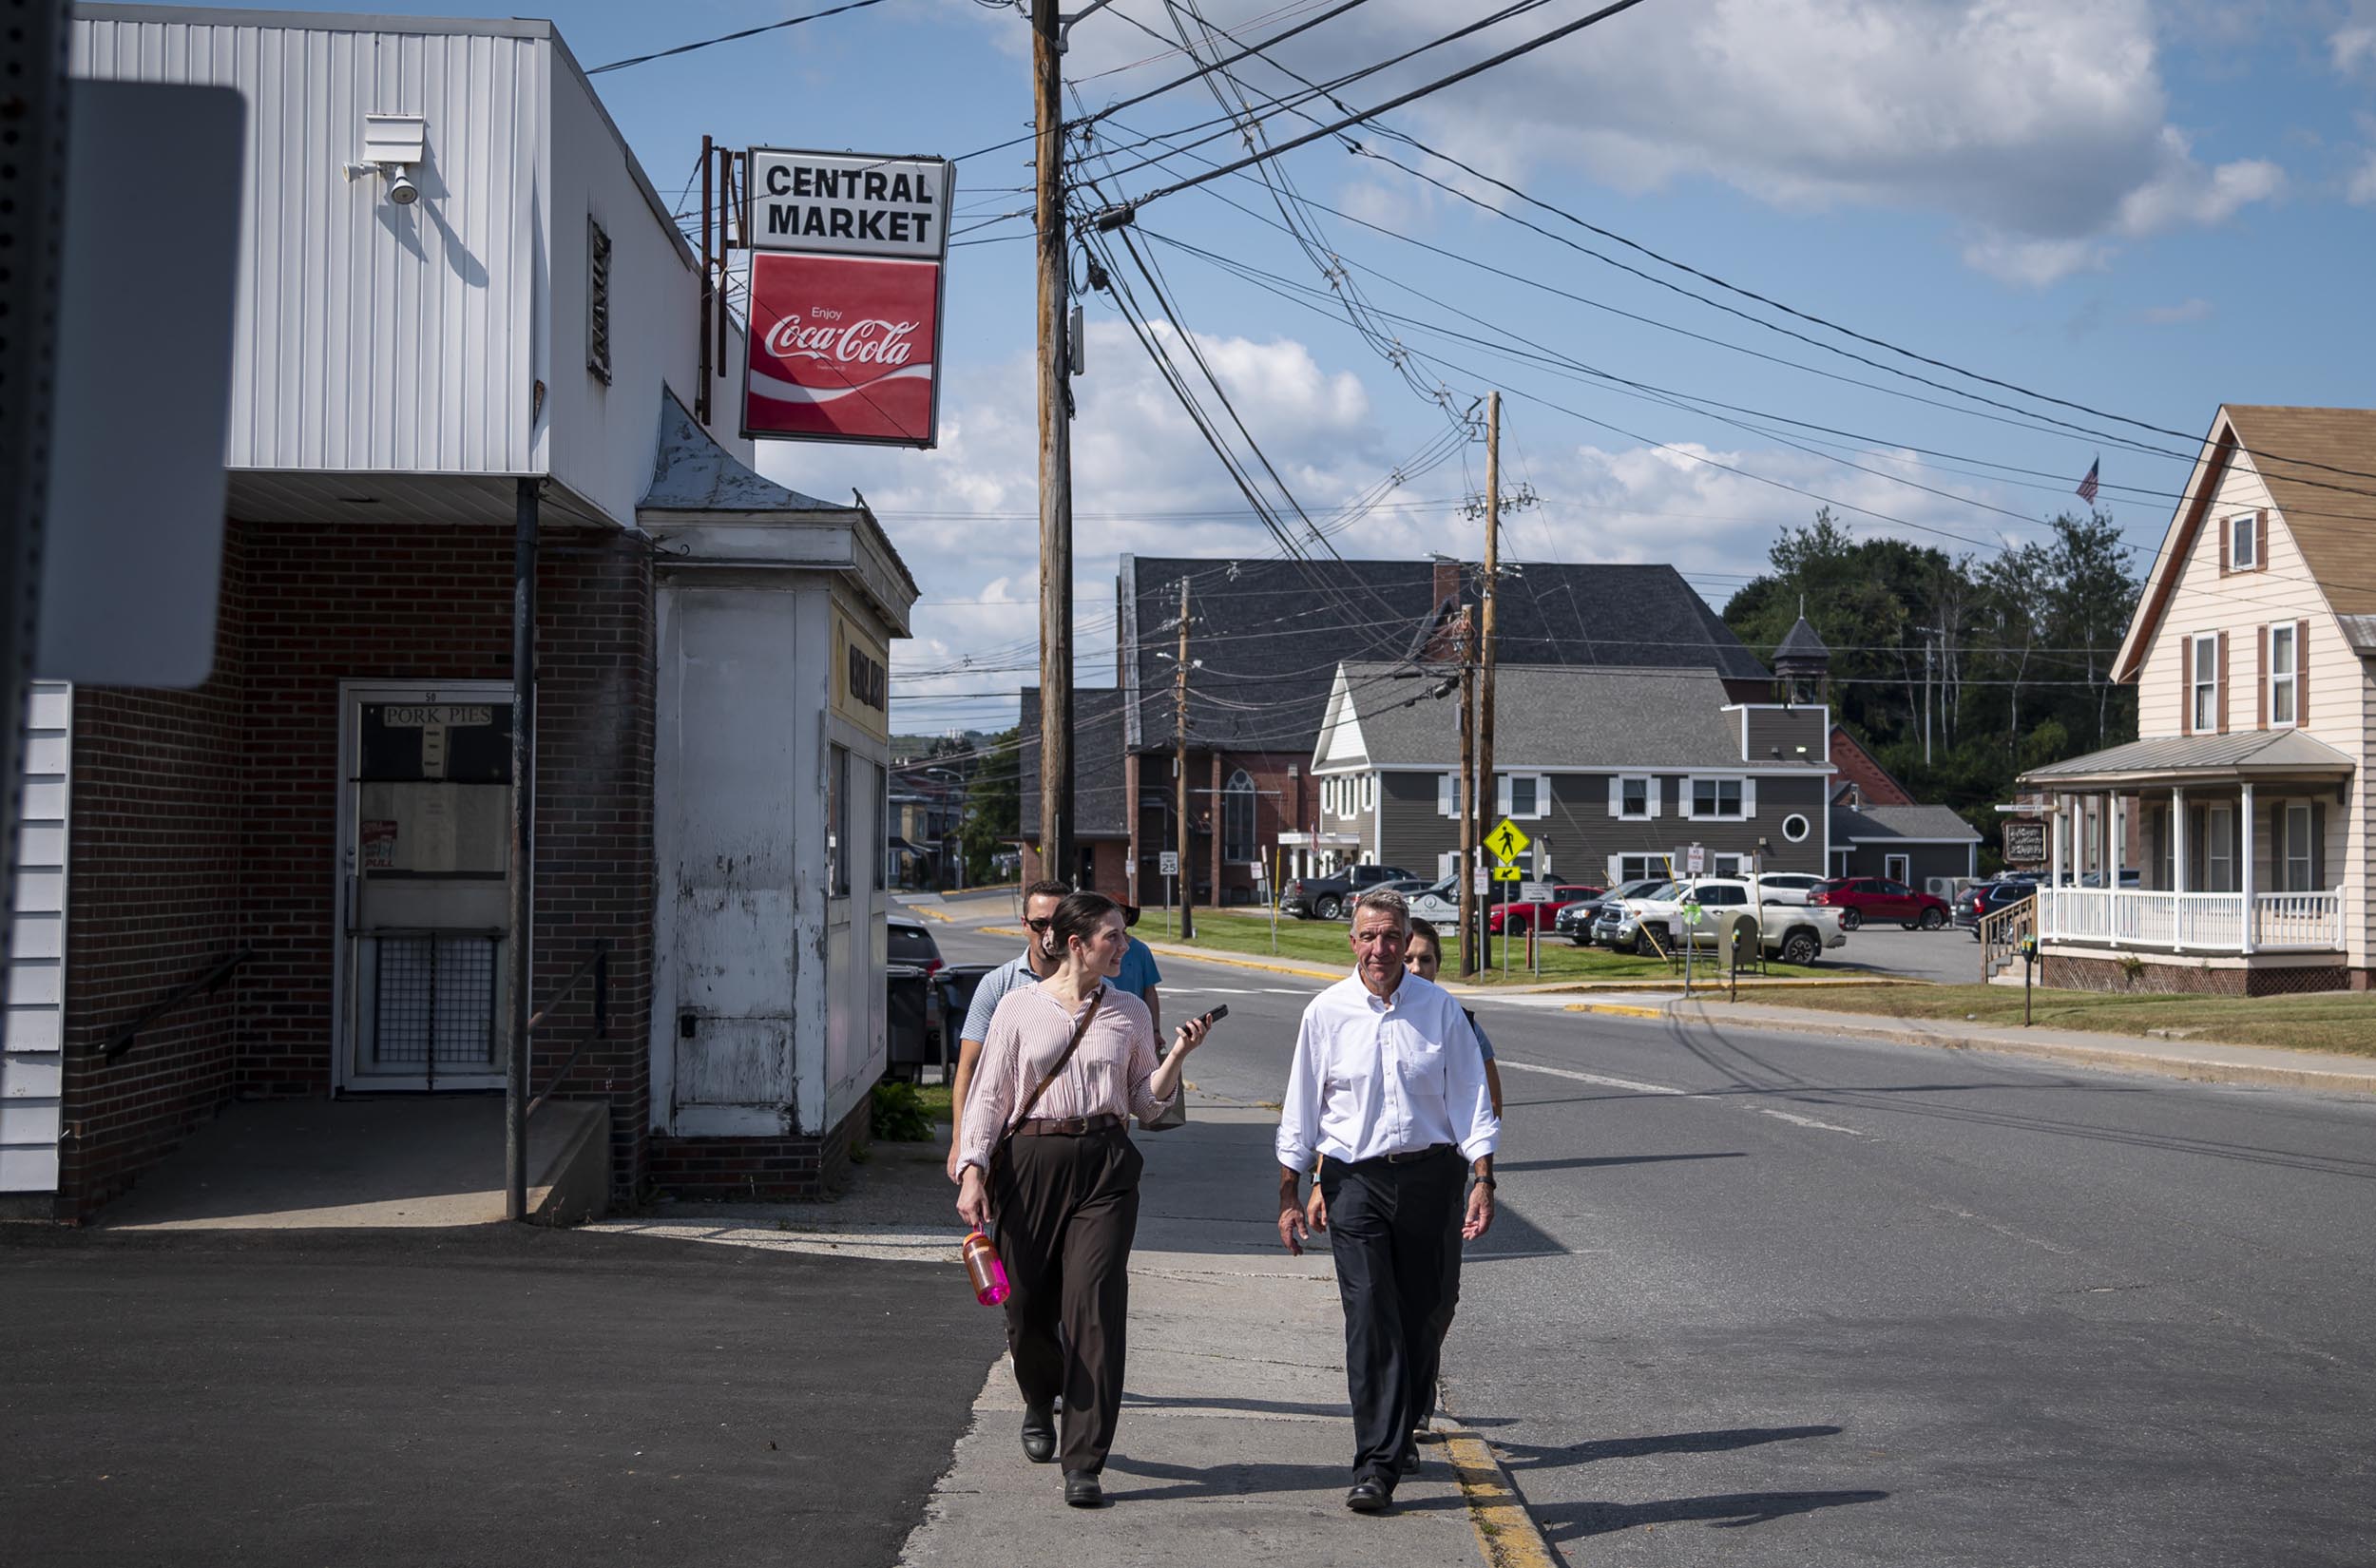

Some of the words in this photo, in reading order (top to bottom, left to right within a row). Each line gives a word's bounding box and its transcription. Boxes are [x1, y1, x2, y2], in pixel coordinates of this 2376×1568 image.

[766, 165, 933, 203] CENTRAL
[768, 204, 931, 243] MARKET
[811, 306, 843, 321] Enjoy
[764, 315, 920, 366] Coca-Cola
[425, 692, 436, 702] 50
[387, 708, 440, 723] PORK
[450, 707, 491, 722] PIES
[364, 858, 394, 868] PULL
[1162, 863, 1176, 872] 25
